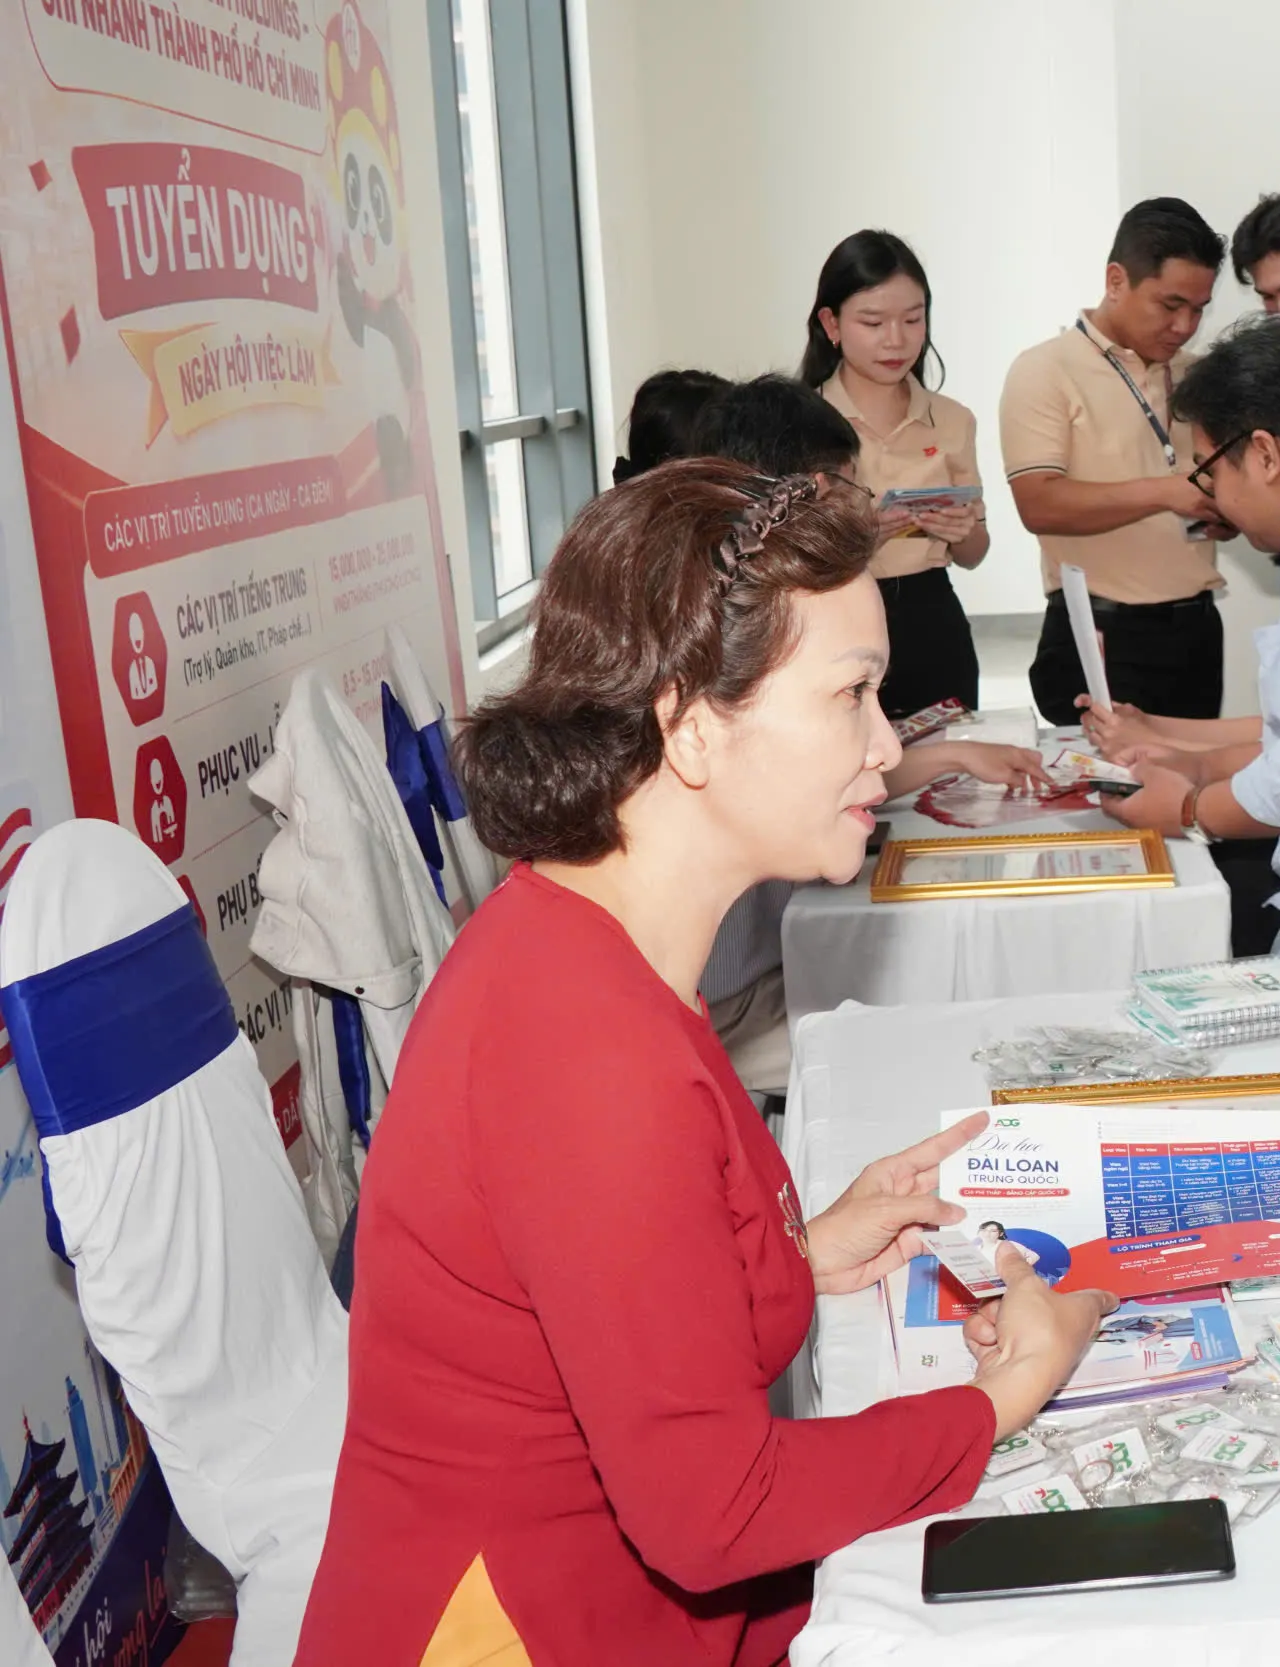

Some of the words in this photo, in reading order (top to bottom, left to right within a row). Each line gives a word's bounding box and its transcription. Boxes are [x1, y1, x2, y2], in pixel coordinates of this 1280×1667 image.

[150, 1, 210, 72] THÀNH
[210, 22, 243, 85] PHỐ
[243, 31, 265, 92] HỒ
[266, 49, 290, 101] CHÍ
[290, 62, 322, 112] MINH
[105, 147, 224, 281] TUYỂN
[225, 191, 310, 295] DỤNG
[178, 343, 223, 407] NGÀY
[226, 333, 252, 393] HỘI
[254, 332, 287, 392] VIỆC
[288, 341, 318, 387] LÀM
[104, 513, 134, 552] CÁC
[134, 515, 152, 550] VỊ
[150, 504, 170, 541] TRÍ
[171, 492, 212, 535] TUYỂN
[213, 496, 245, 533] DỤNG
[265, 482, 292, 515] NGÀY
[177, 593, 205, 640] CÁC
[203, 597, 221, 635] VỊ
[218, 586, 239, 624] TRÍ
[238, 569, 272, 618] TIẾNG
[271, 567, 307, 605] TRUNG
[183, 657, 204, 686] (Trợ
[215, 644, 239, 671] Quản
[198, 744, 240, 799] PHỤC
[216, 879, 249, 932] PHỤ
[265, 990, 282, 1032] VỊ
[994, 1118, 1021, 1128] ADG
[967, 1153, 999, 1171] ĐÀI
[1005, 1158, 1059, 1173] LOAN
[968, 1174, 1014, 1184] (TRUNG
[1017, 1173, 1059, 1184] QUỐC)
[1154, 1239, 1177, 1247] THAM
